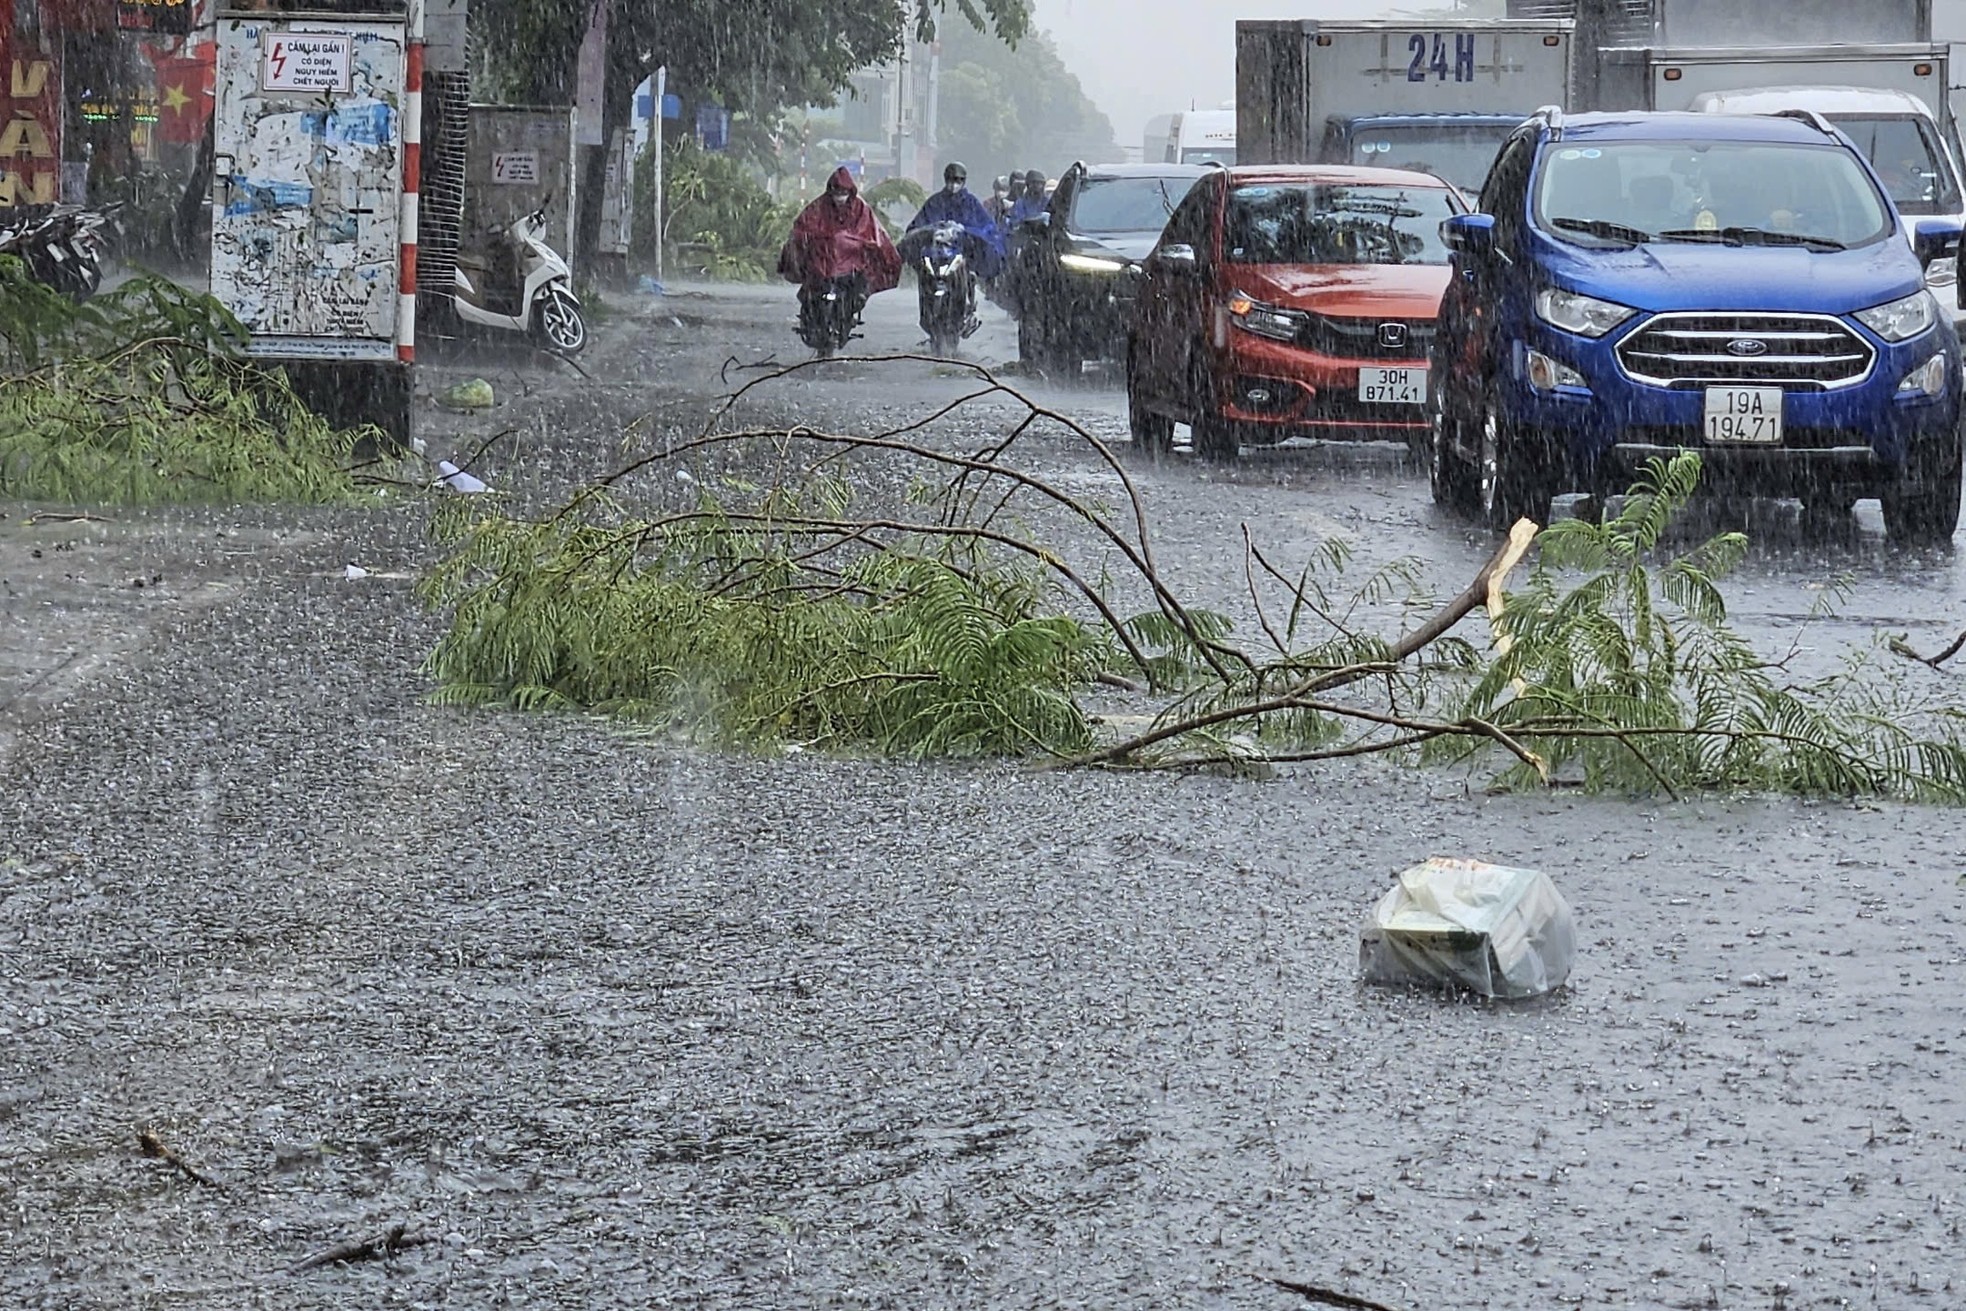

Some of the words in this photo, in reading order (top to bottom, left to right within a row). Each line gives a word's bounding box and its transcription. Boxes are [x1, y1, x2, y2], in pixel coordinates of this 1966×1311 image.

[1408, 33, 1475, 82] 24H
[1379, 370, 1408, 384] 30H
[1366, 386, 1418, 401] 871.41
[1727, 391, 1763, 415] 19A
[1710, 416, 1776, 440] 194.71
